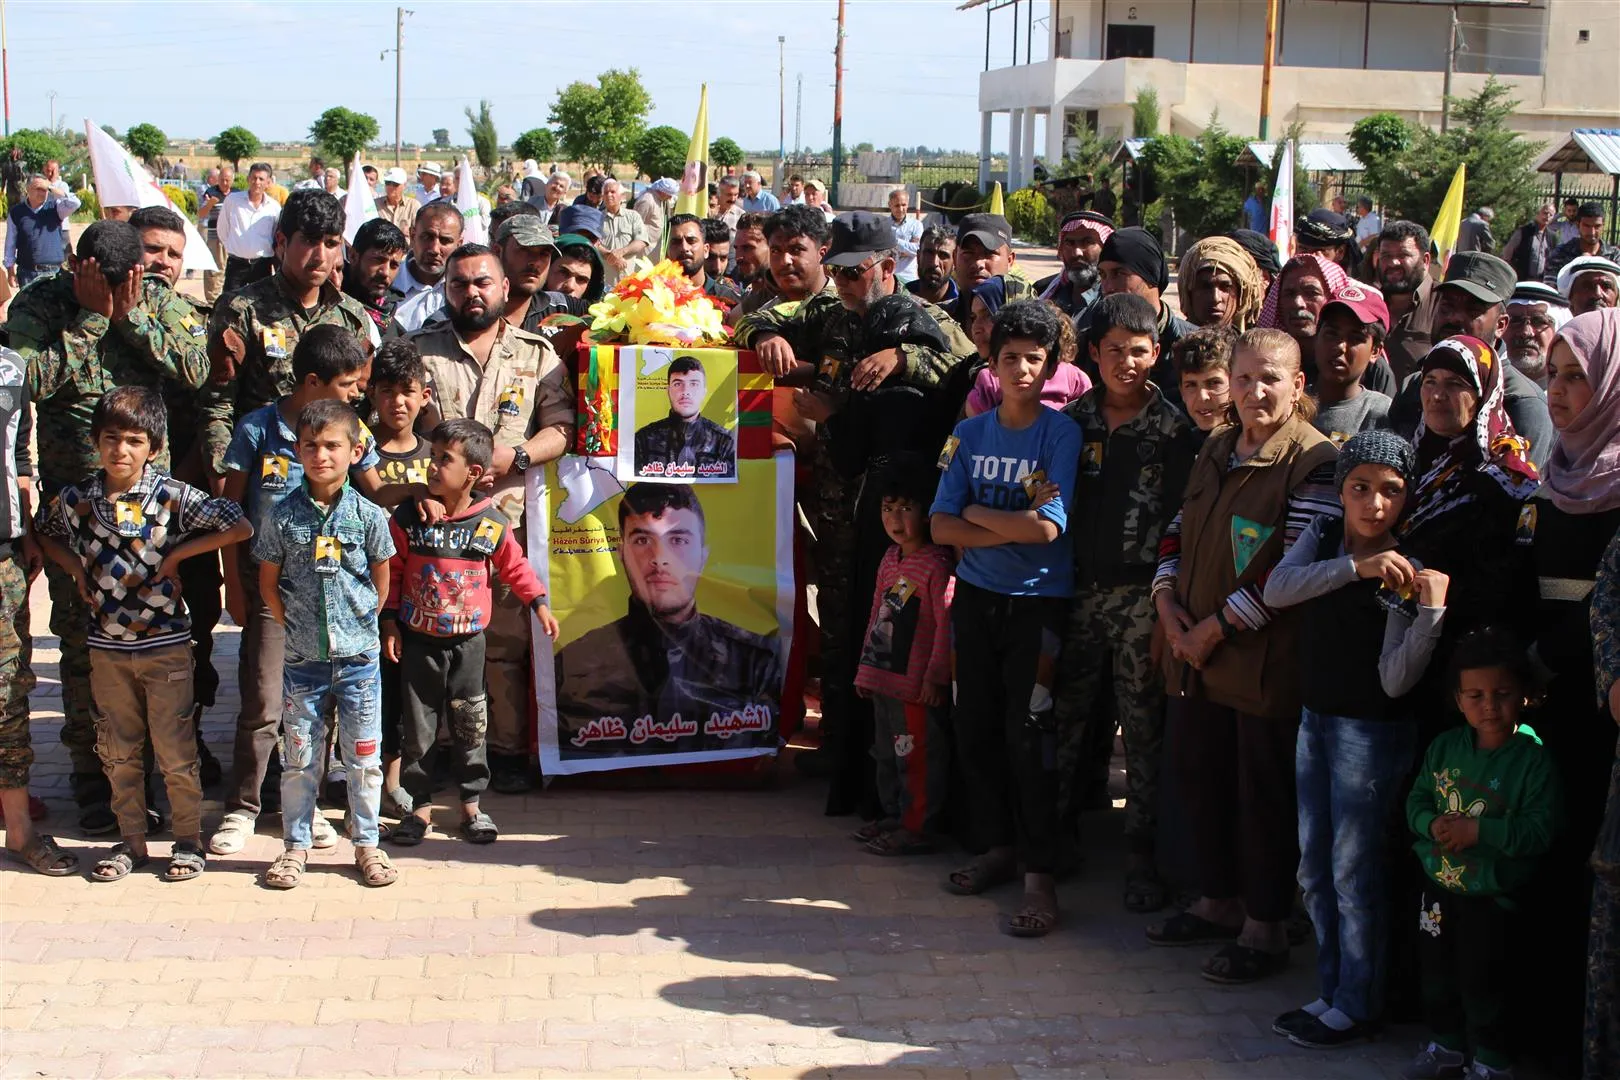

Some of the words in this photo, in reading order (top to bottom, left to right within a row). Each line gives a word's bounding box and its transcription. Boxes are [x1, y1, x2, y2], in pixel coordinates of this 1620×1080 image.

[665, 461, 695, 477] سليمان
[698, 461, 728, 477] الشهيد
[571, 716, 627, 746] ظاهر
[630, 713, 698, 744] سليمان
[705, 703, 771, 739] الشهيد
